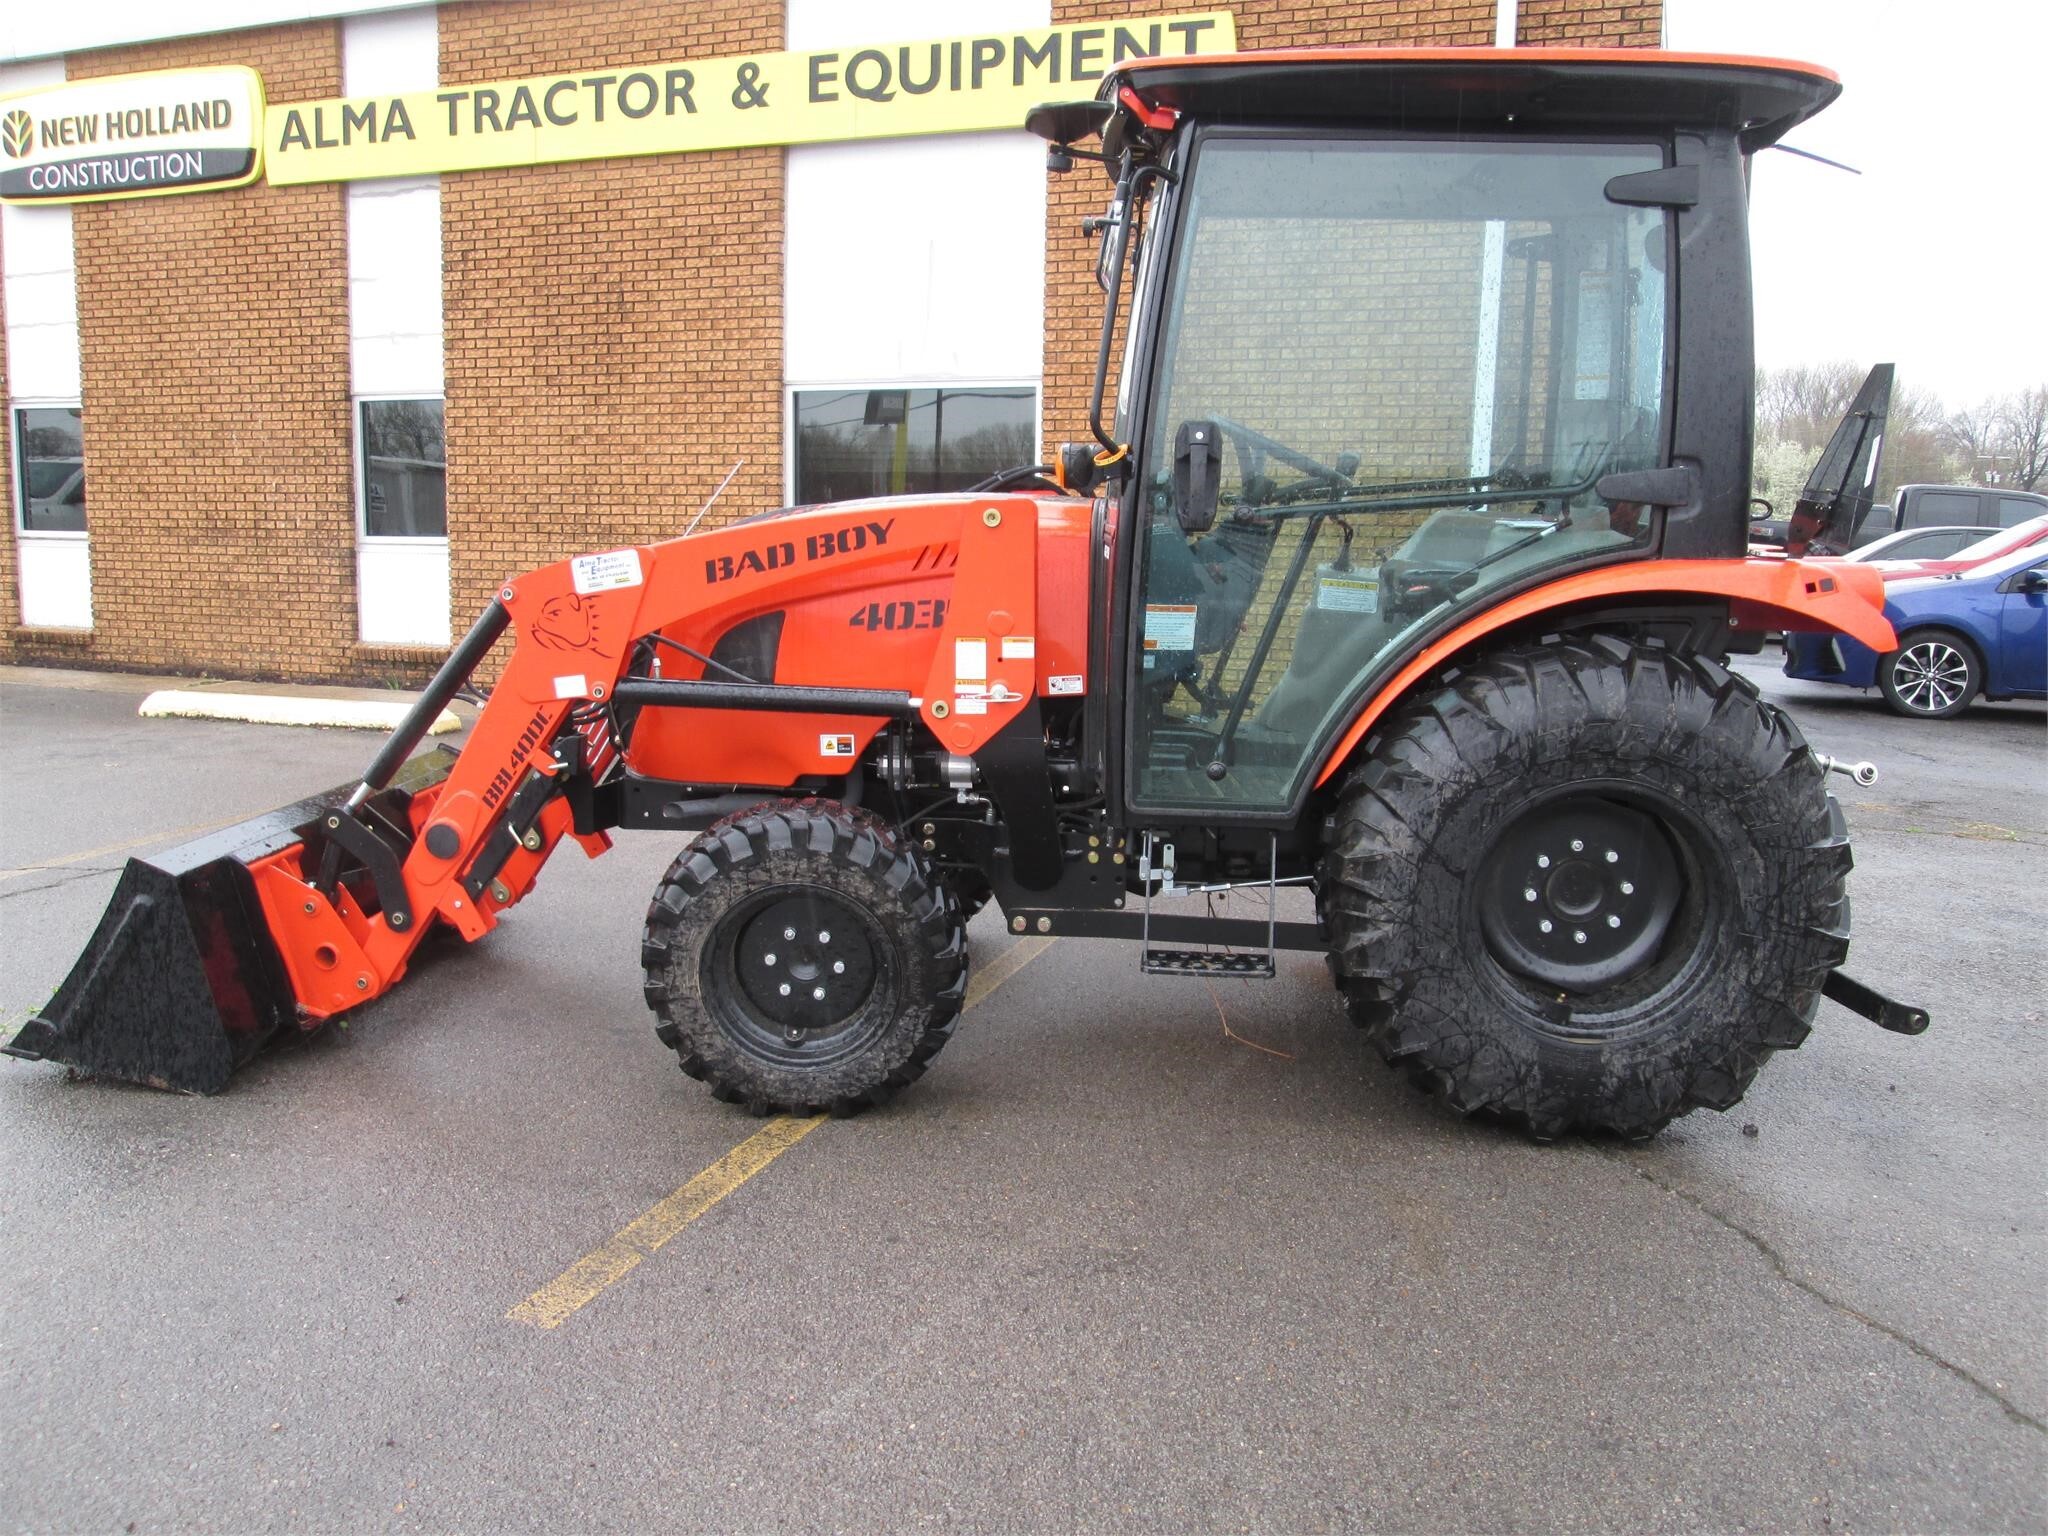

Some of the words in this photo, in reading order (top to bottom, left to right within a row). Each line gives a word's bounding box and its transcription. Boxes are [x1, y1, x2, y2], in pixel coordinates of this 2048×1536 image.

[279, 98, 416, 152] ALMA
[436, 68, 698, 137] TRACTOR
[731, 61, 770, 110] &
[808, 19, 1216, 103] EQUIPMENT
[41, 113, 98, 149] NEW
[106, 98, 232, 140] HOLLAND
[29, 151, 203, 191] CONSTRUCTION
[706, 541, 796, 585] BAD
[806, 518, 895, 561] BOY
[849, 599, 950, 632] 403
